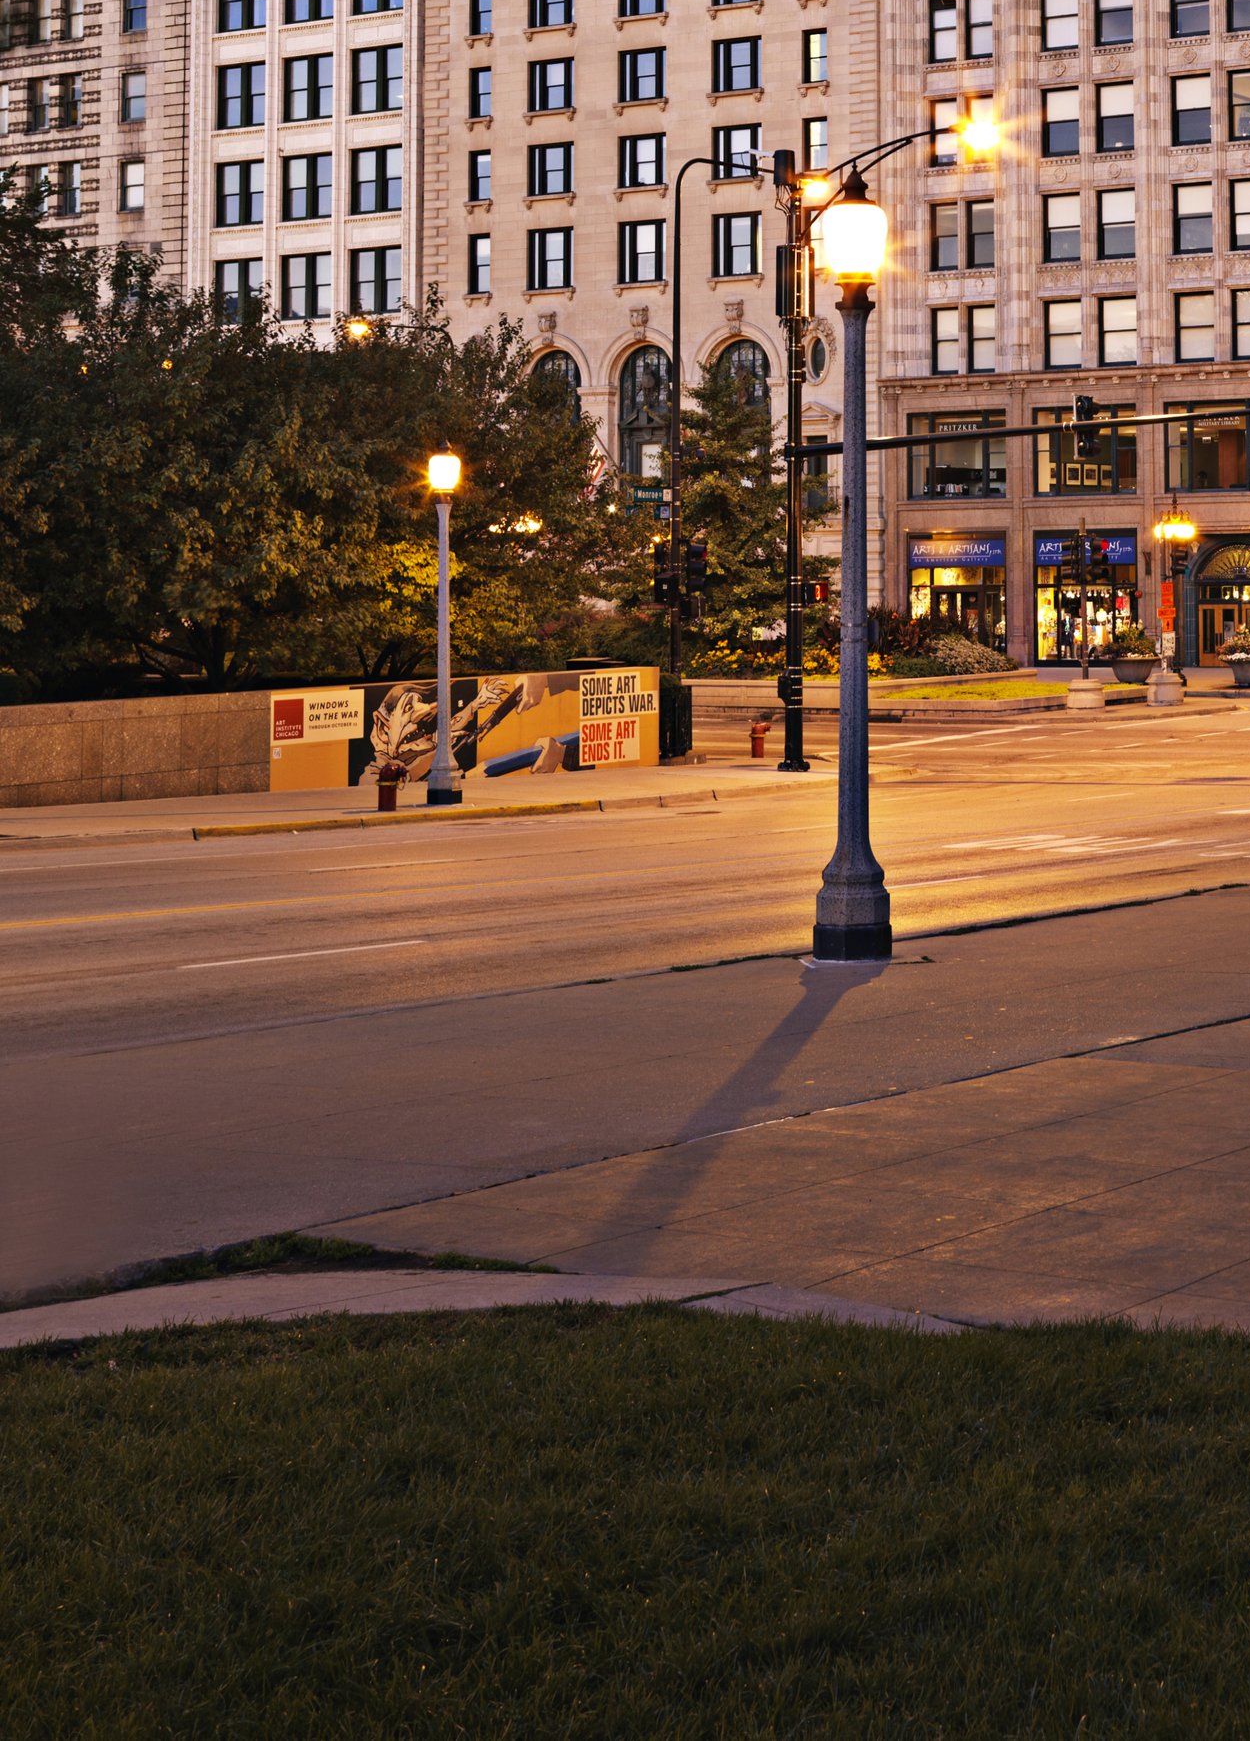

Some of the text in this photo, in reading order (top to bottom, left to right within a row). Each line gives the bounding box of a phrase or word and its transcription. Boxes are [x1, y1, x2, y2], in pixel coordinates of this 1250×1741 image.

[939, 423, 977, 431] PRITZKER
[637, 489, 659, 499] Monroe
[912, 545, 935, 556] ARTS
[582, 675, 636, 697] SOME ART
[309, 700, 349, 710] WINDOWS
[582, 693, 656, 716] DEPICTS WAR.
[309, 711, 359, 722] ON THE WAR
[276, 730, 299, 738] CHICAGO
[582, 720, 636, 743] SOME ART
[582, 741, 625, 763] ENDS IT.
